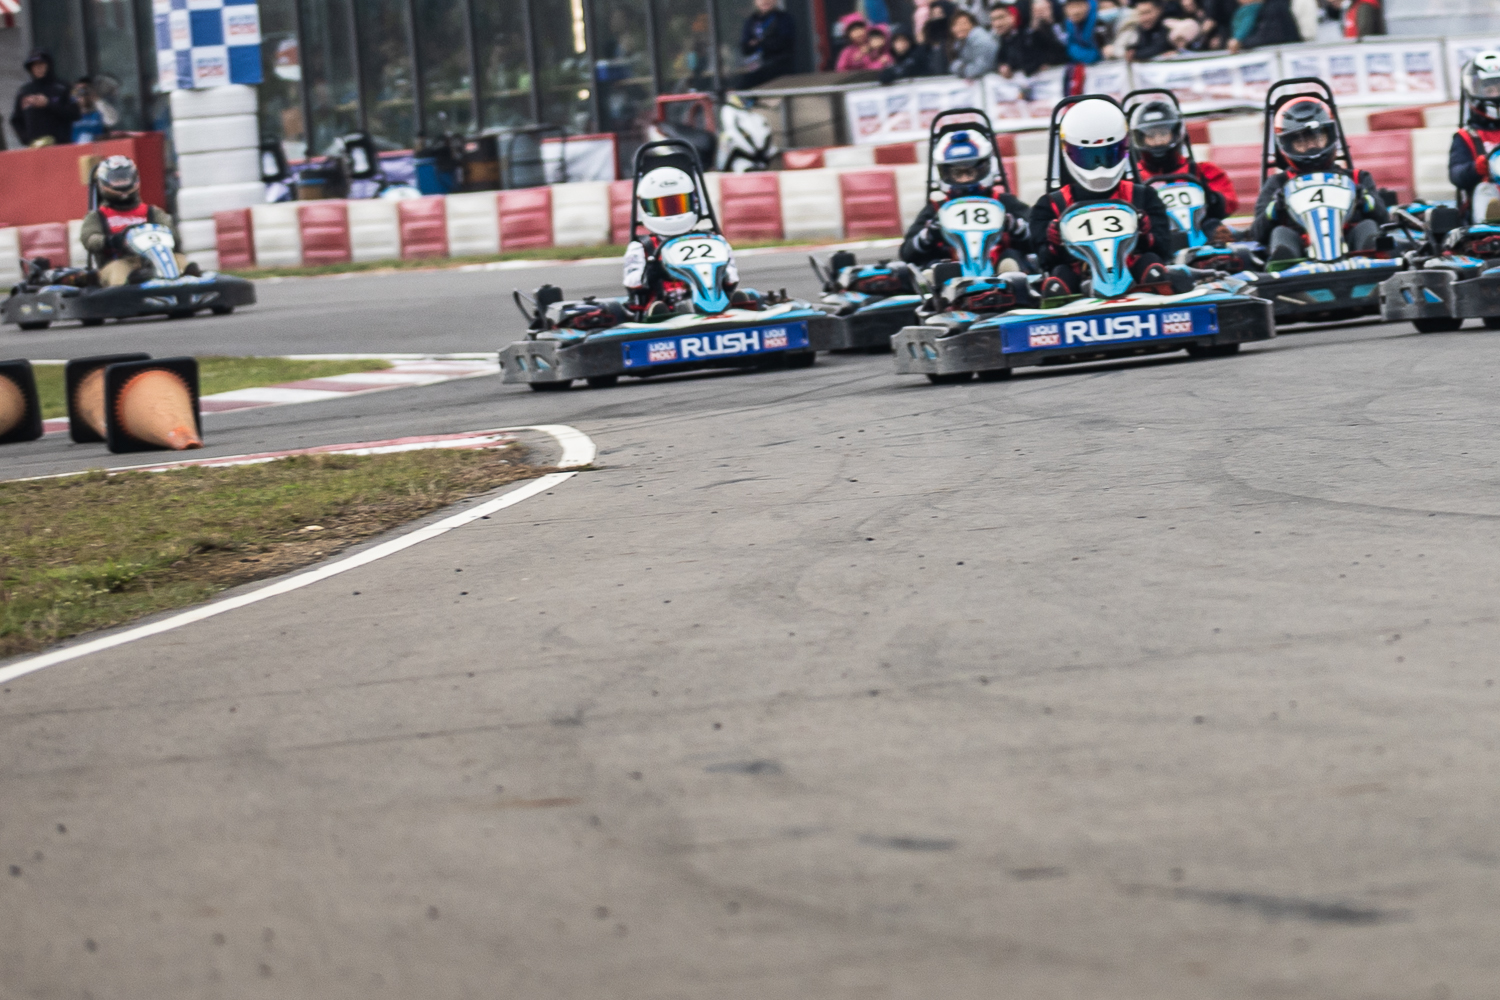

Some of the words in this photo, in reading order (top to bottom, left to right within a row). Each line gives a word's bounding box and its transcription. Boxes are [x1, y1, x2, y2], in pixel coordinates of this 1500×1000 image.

[1163, 191, 1193, 207] 20
[1309, 188, 1325, 203] 4
[955, 207, 990, 225] 18
[1077, 215, 1124, 237] 13
[679, 243, 716, 262] 22
[1163, 312, 1191, 323] LIQUI
[1029, 324, 1058, 336] LIQUI
[1065, 314, 1157, 344] RUSH
[1163, 322, 1192, 334] MOLY
[681, 330, 760, 358] RUSH
[1030, 335, 1060, 347] MOLY
